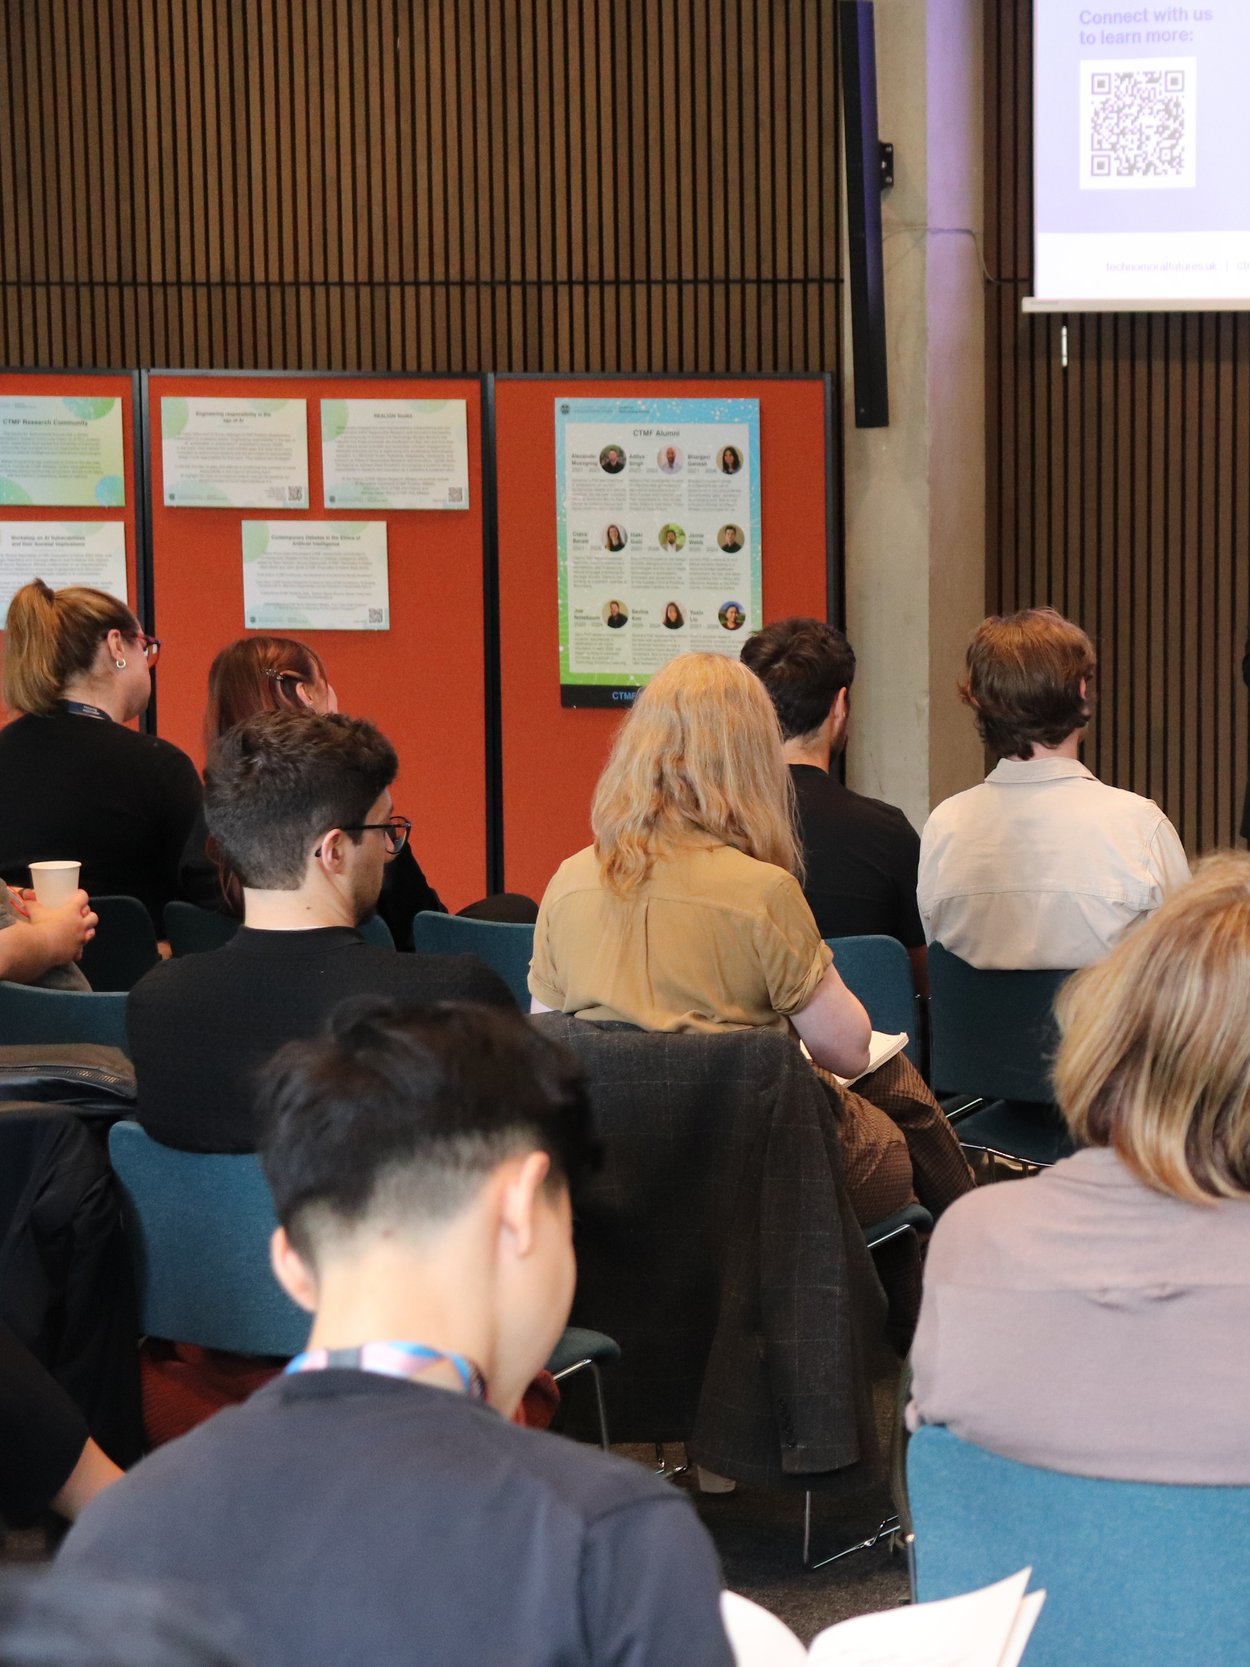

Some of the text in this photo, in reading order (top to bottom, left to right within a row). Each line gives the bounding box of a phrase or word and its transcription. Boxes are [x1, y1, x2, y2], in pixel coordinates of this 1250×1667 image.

[1079, 6, 1214, 25] Connect with us
[1080, 30, 1194, 45] to learn more:
[633, 429, 681, 437] CTMF Alumni
